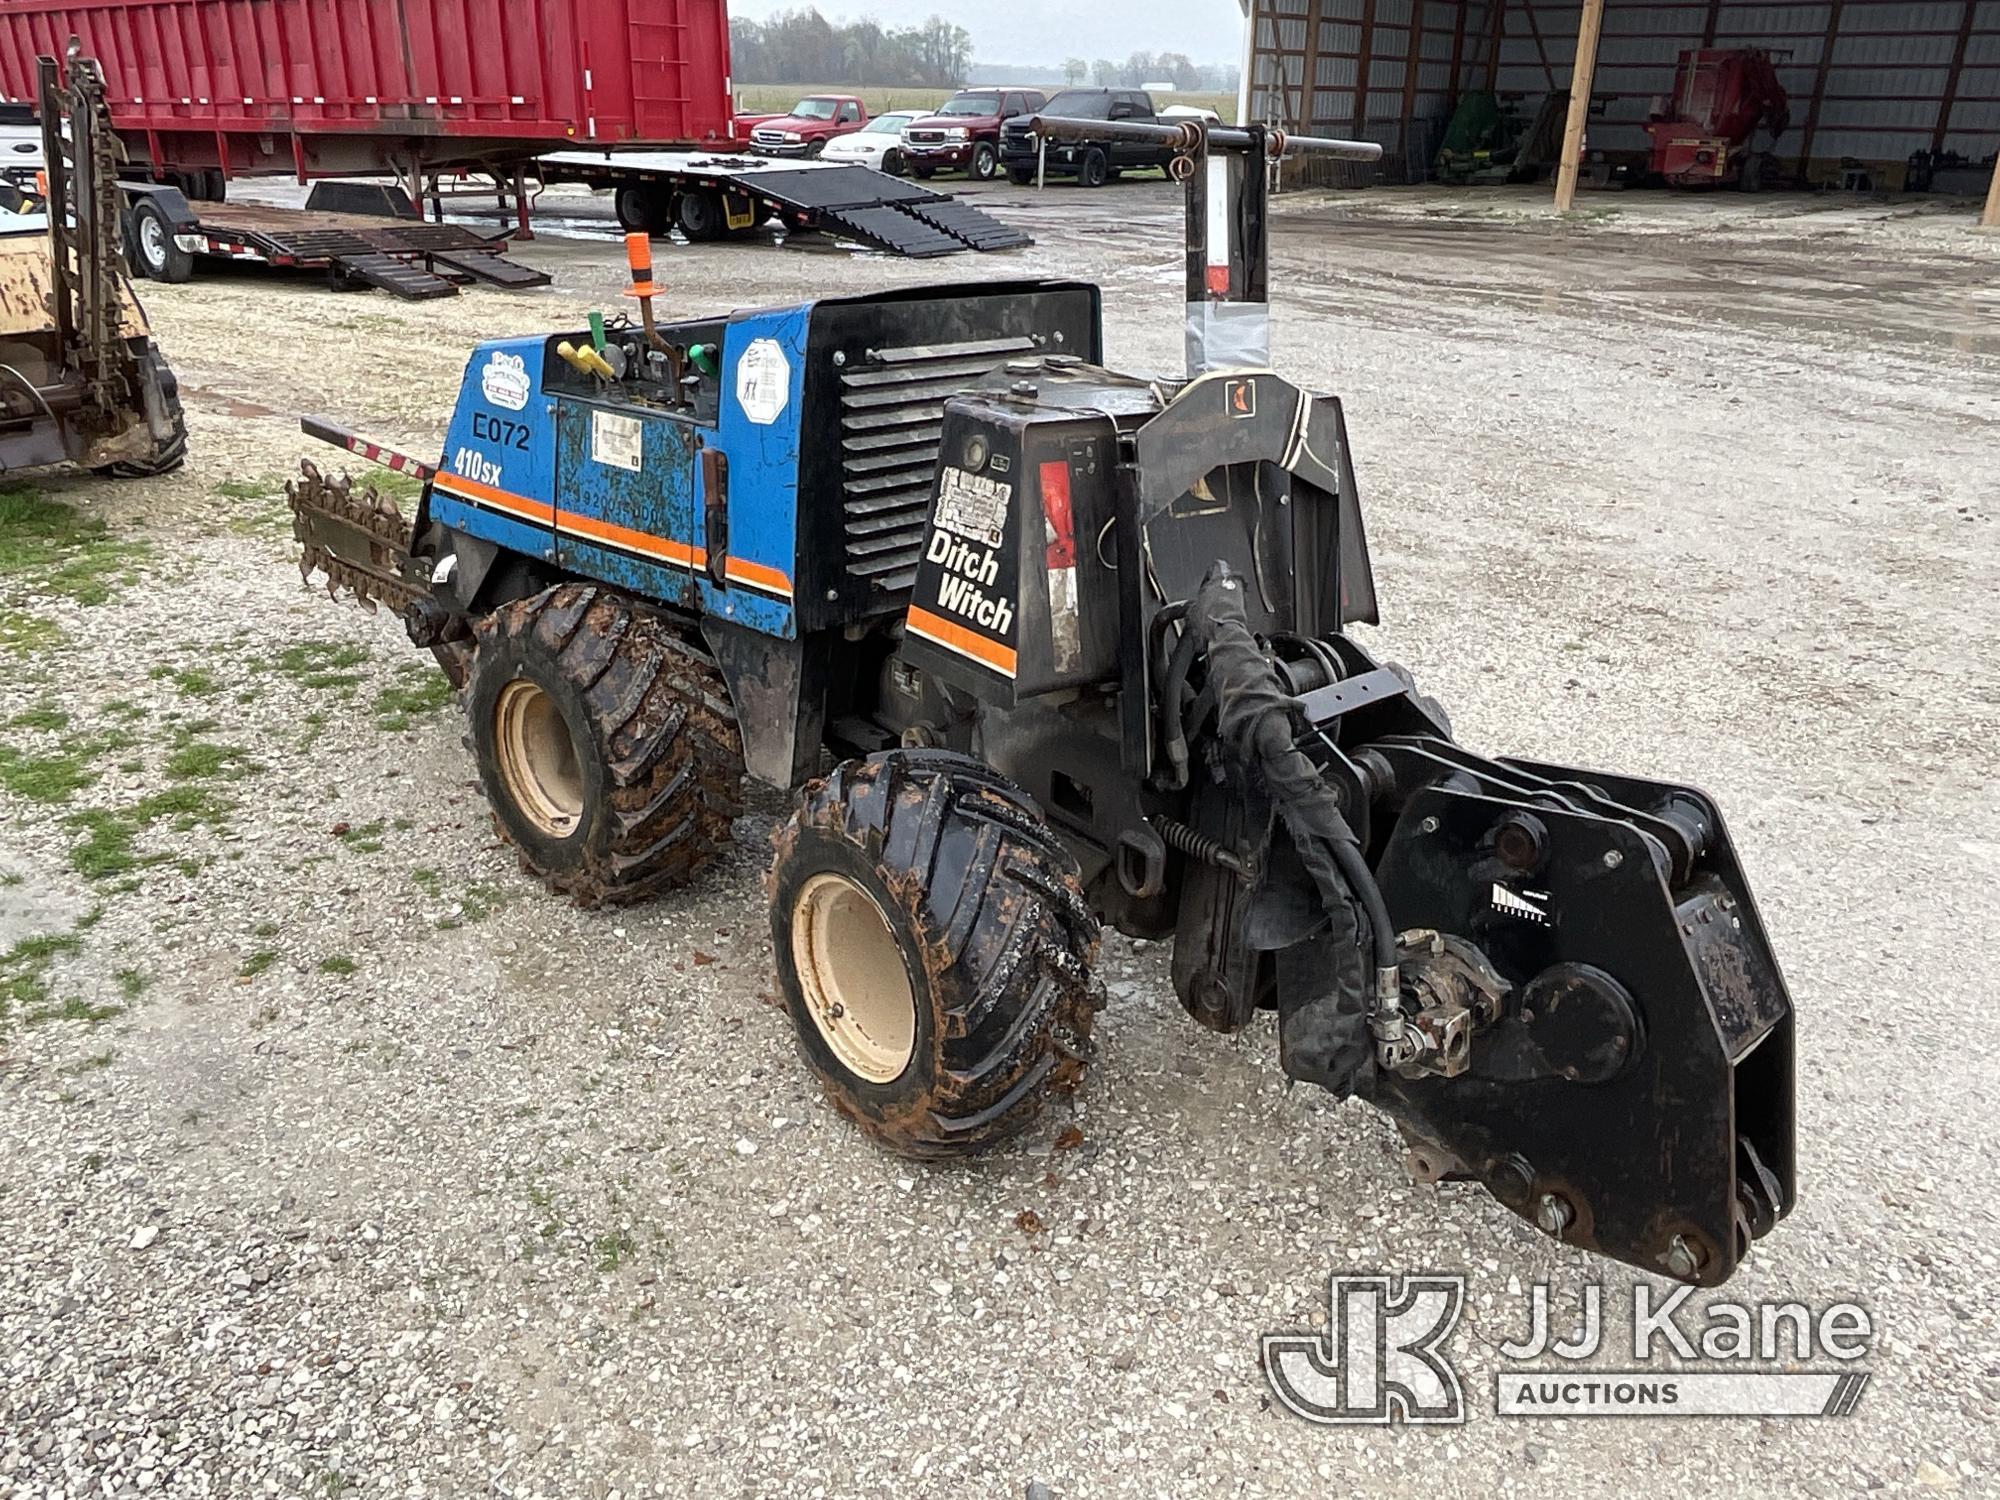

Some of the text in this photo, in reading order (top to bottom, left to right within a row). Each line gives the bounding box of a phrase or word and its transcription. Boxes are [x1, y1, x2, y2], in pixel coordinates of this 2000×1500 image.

[473, 412, 530, 452] E072
[926, 529, 999, 587] Ditch
[937, 572, 1013, 635] Witch
